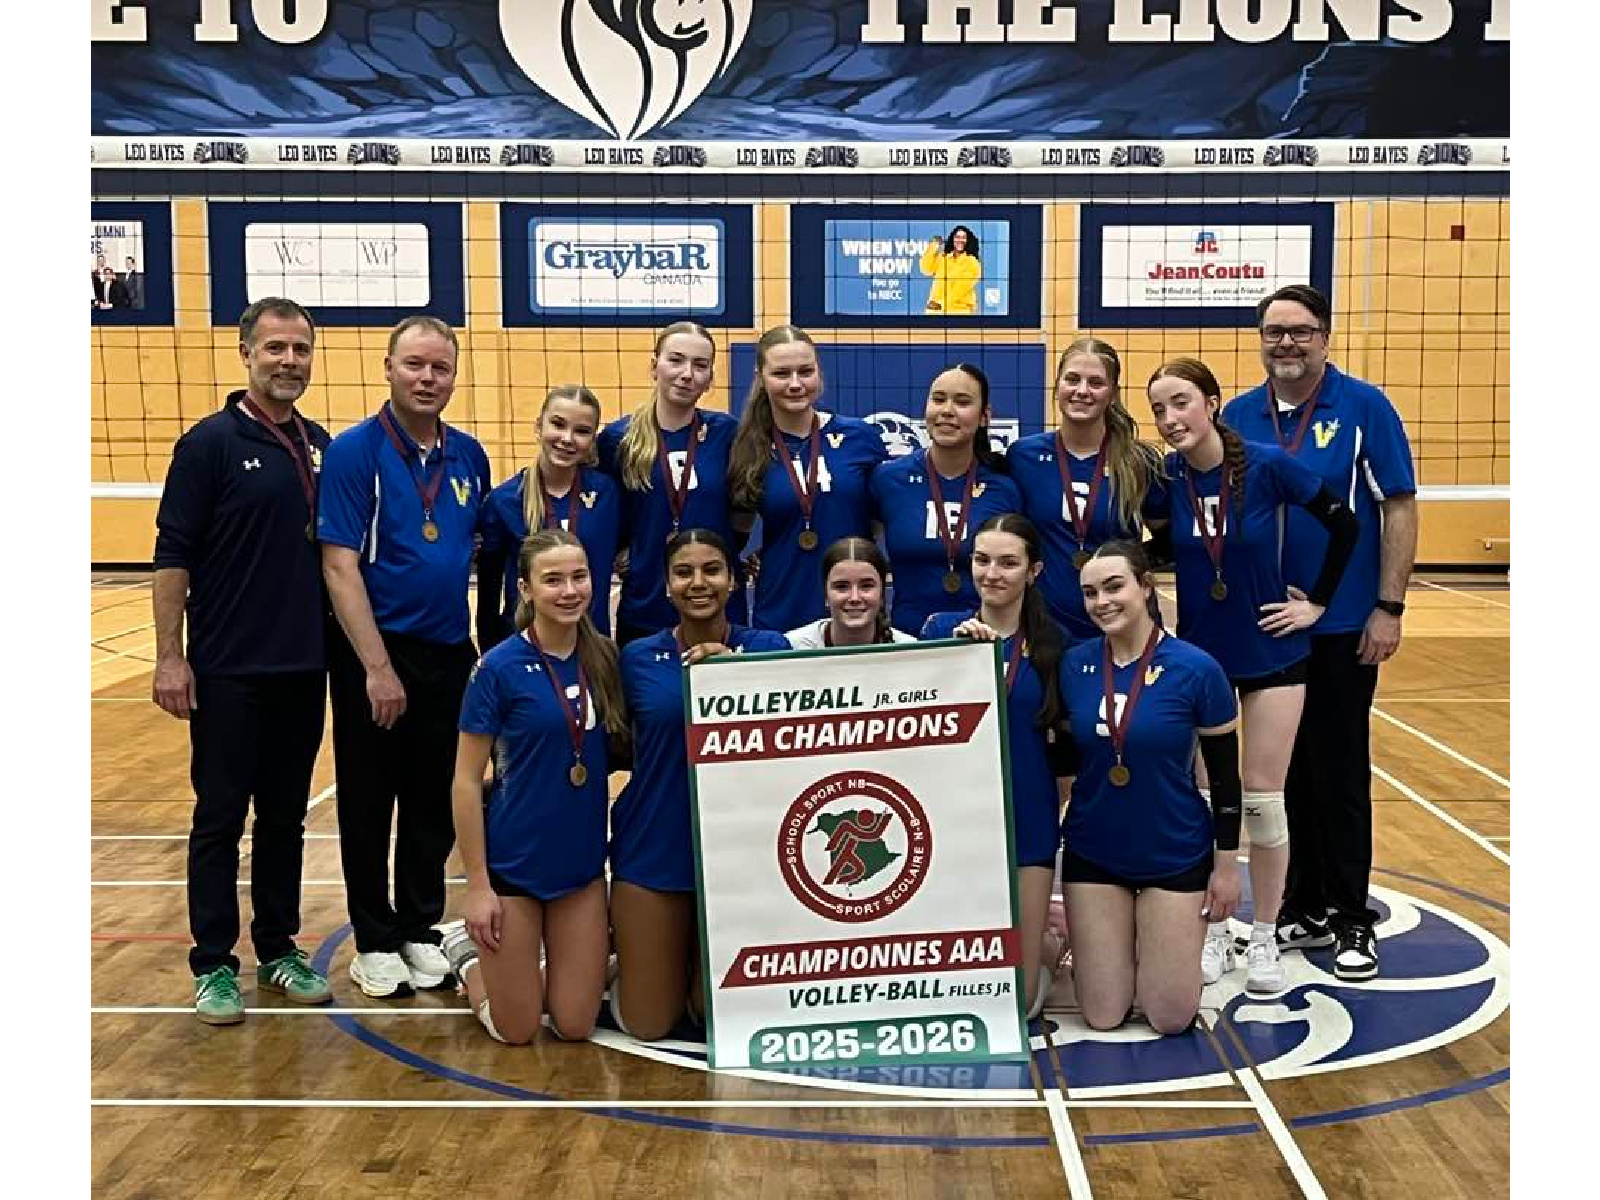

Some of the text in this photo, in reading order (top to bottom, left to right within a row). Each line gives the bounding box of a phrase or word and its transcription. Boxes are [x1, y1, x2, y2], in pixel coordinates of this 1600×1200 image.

[125, 143, 146, 161] LEO
[279, 145, 299, 162] LEO
[431, 146, 452, 164] LEO
[585, 148, 605, 165] LEO
[737, 148, 757, 166] LEO
[889, 149, 910, 167] LEO
[1041, 148, 1062, 166] LEO
[1194, 148, 1215, 165] LEO
[1349, 146, 1369, 164] LEO
[842, 239, 892, 256] WHEN
[859, 258, 913, 274] KNOW
[643, 274, 702, 285] CANADA
[698, 686, 938, 719] VOLLEYBALL JR. GIRLS
[700, 711, 960, 756] AAA CHAMPIONS
[786, 779, 866, 864] SCHOOL SPORT NB
[835, 901, 880, 916] SPORT
[885, 846, 925, 905] SCOLAIRE
[743, 936, 1004, 979] CHAMPIONNES AAA
[789, 979, 1011, 1009] VOLLEY-BALL FILLES JR
[761, 1019, 976, 1064] 2025-2026
